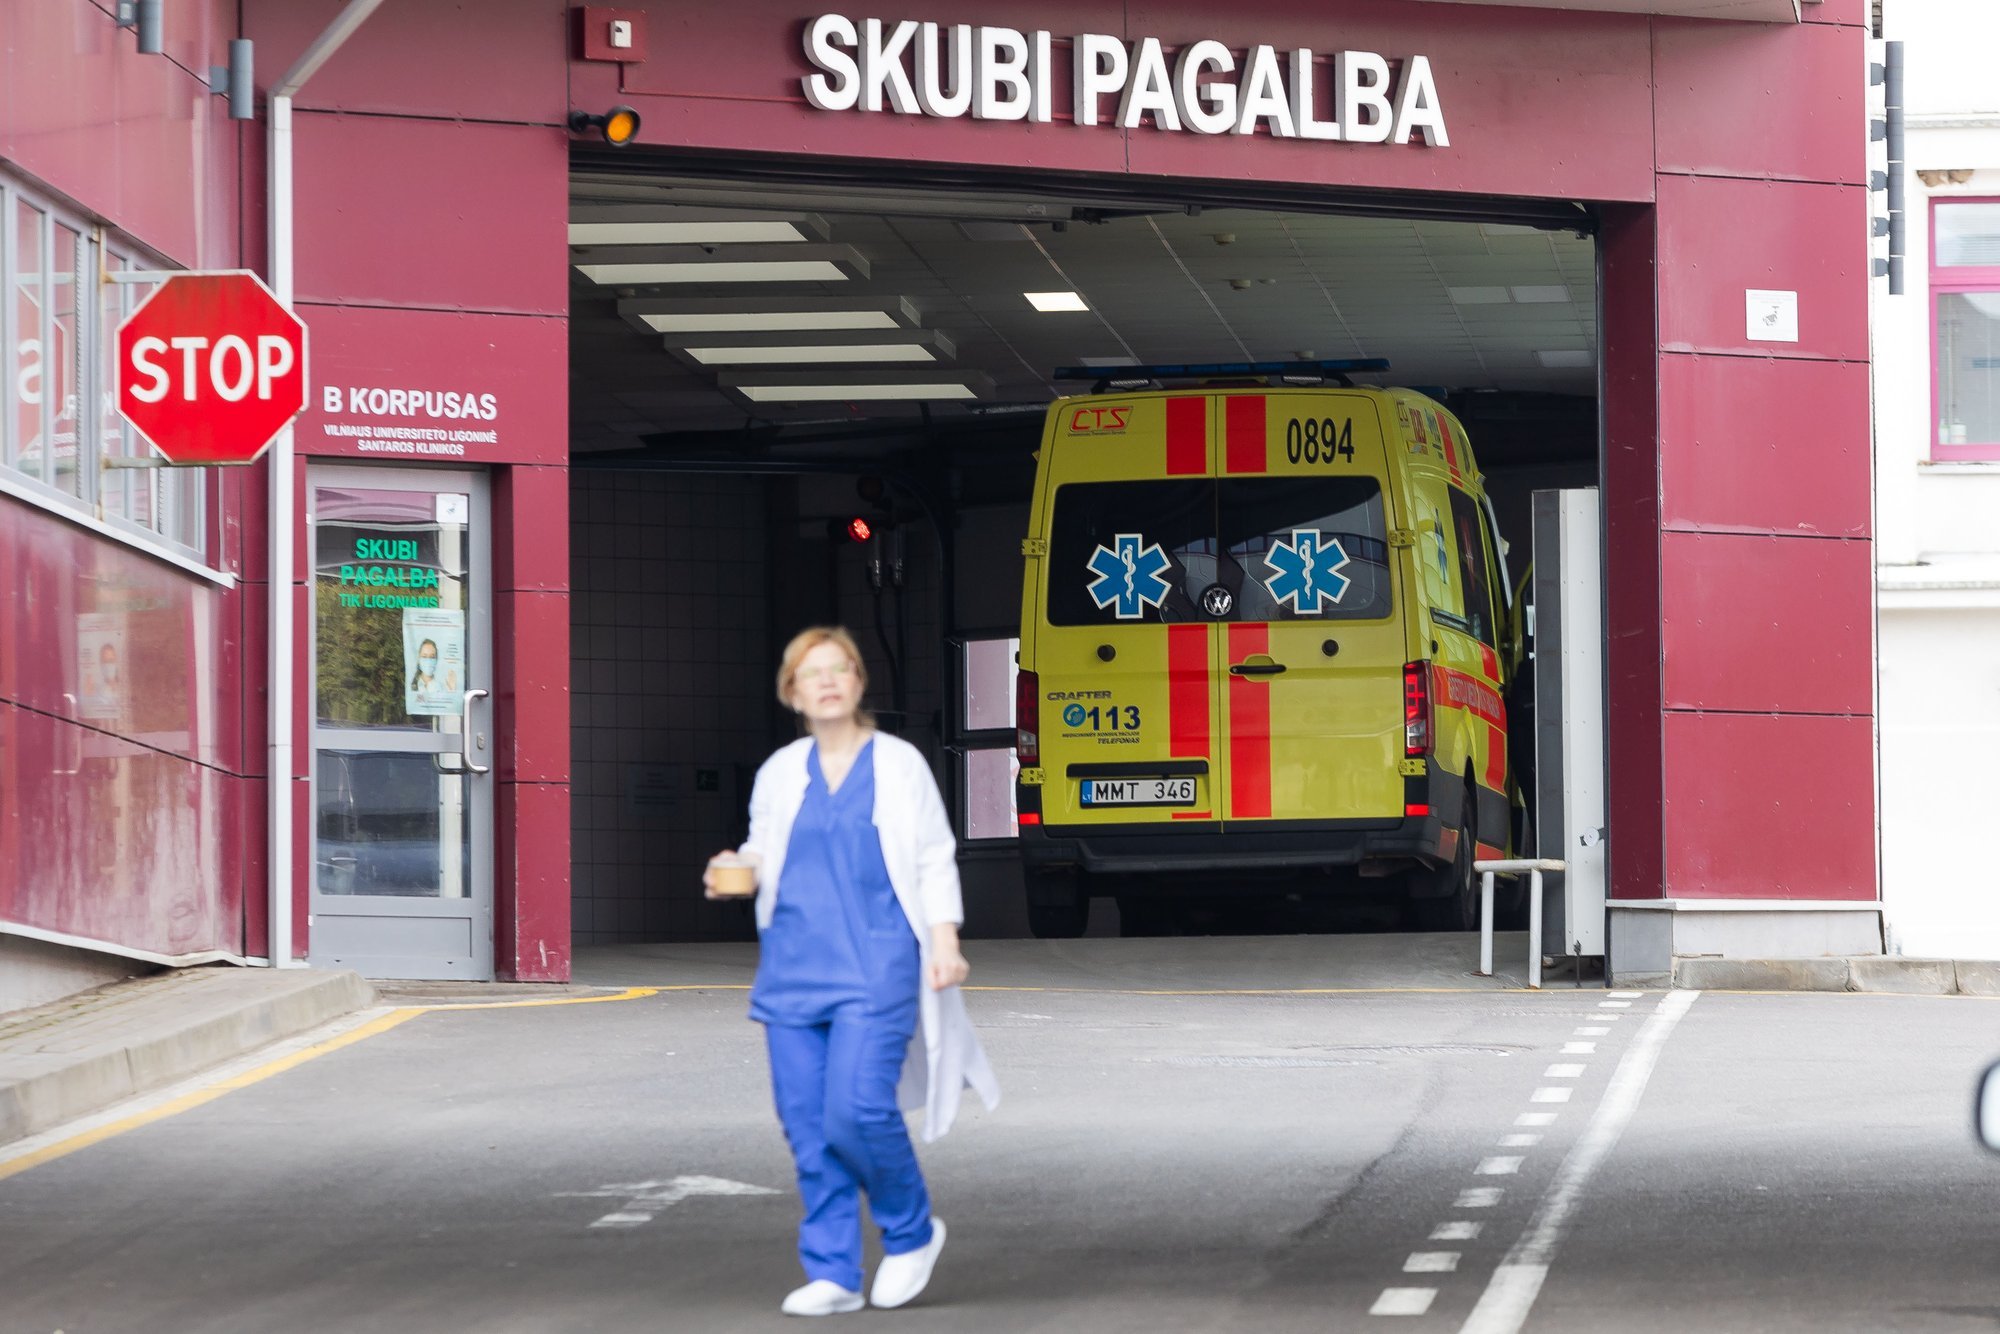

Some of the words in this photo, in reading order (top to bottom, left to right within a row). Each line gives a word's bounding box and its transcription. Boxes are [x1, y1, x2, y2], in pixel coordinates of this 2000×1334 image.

[803, 14, 1051, 122] SKUBI
[1074, 33, 1449, 146] PAGALBA
[129, 334, 294, 403] STOP
[323, 386, 343, 412] B
[350, 387, 497, 421] KORPUSAS
[1071, 407, 1129, 431] CTS
[323, 424, 373, 438] VILNIAUS
[373, 426, 447, 441] UNIVERSITETO
[448, 430, 497, 444] LIGONINĖ
[1286, 417, 1355, 464] 0894
[357, 439, 415, 454] SANTAROS
[416, 442, 465, 456] KLINIKOS
[355, 538, 418, 560] SKUBI
[340, 565, 439, 588] PAGALBA
[338, 593, 361, 608] TIK
[364, 594, 439, 609] LIGONIAMS
[1046, 690, 1112, 701] CRAFTER
[1087, 705, 1141, 731] 113
[1095, 782, 1139, 801] MMT
[1154, 781, 1191, 799] 346
